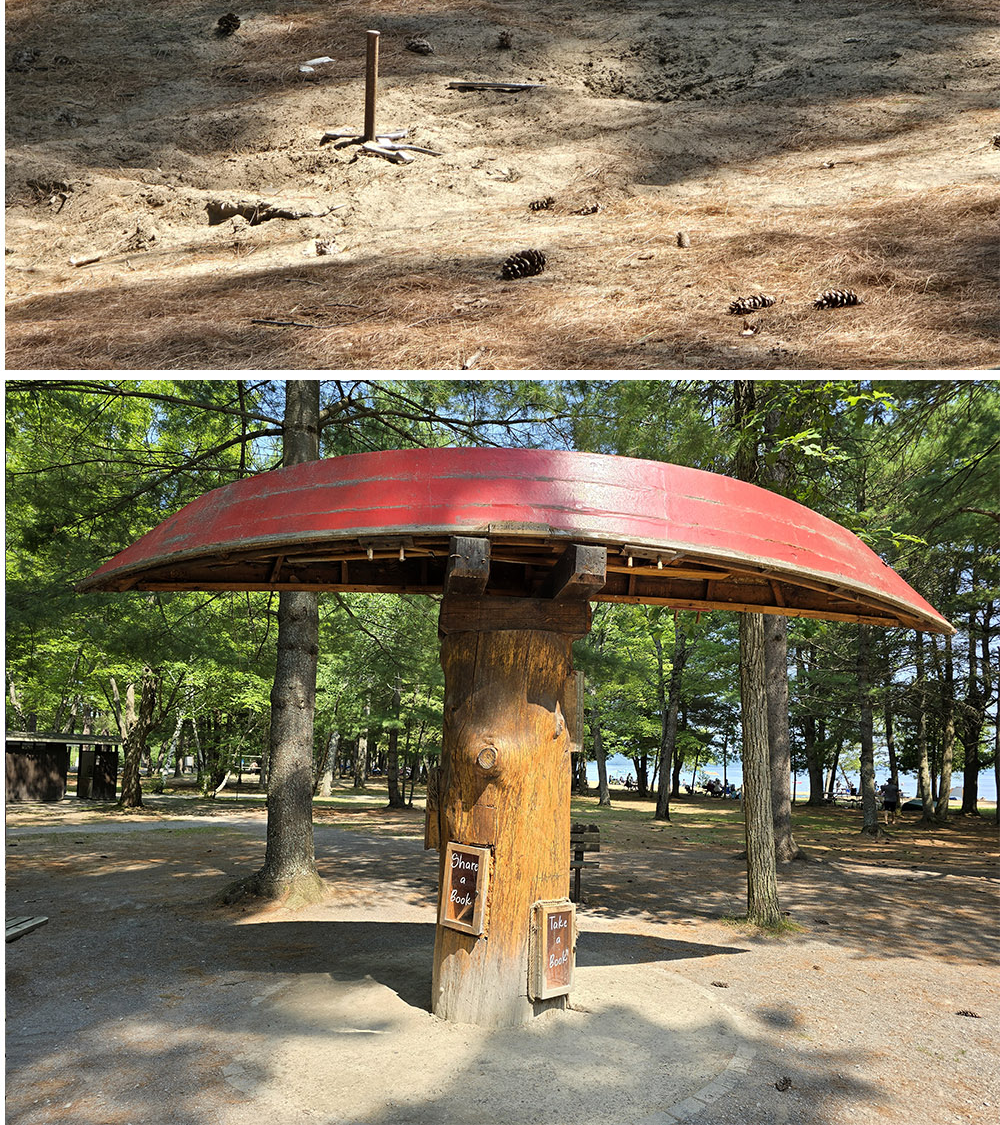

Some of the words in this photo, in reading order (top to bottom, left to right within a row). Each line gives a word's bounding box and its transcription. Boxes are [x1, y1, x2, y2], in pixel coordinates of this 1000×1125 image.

[451, 853, 479, 872] Share
[460, 876, 466, 884] a
[450, 889, 472, 906] Book
[549, 915, 567, 931] Take
[556, 936, 561, 944] a
